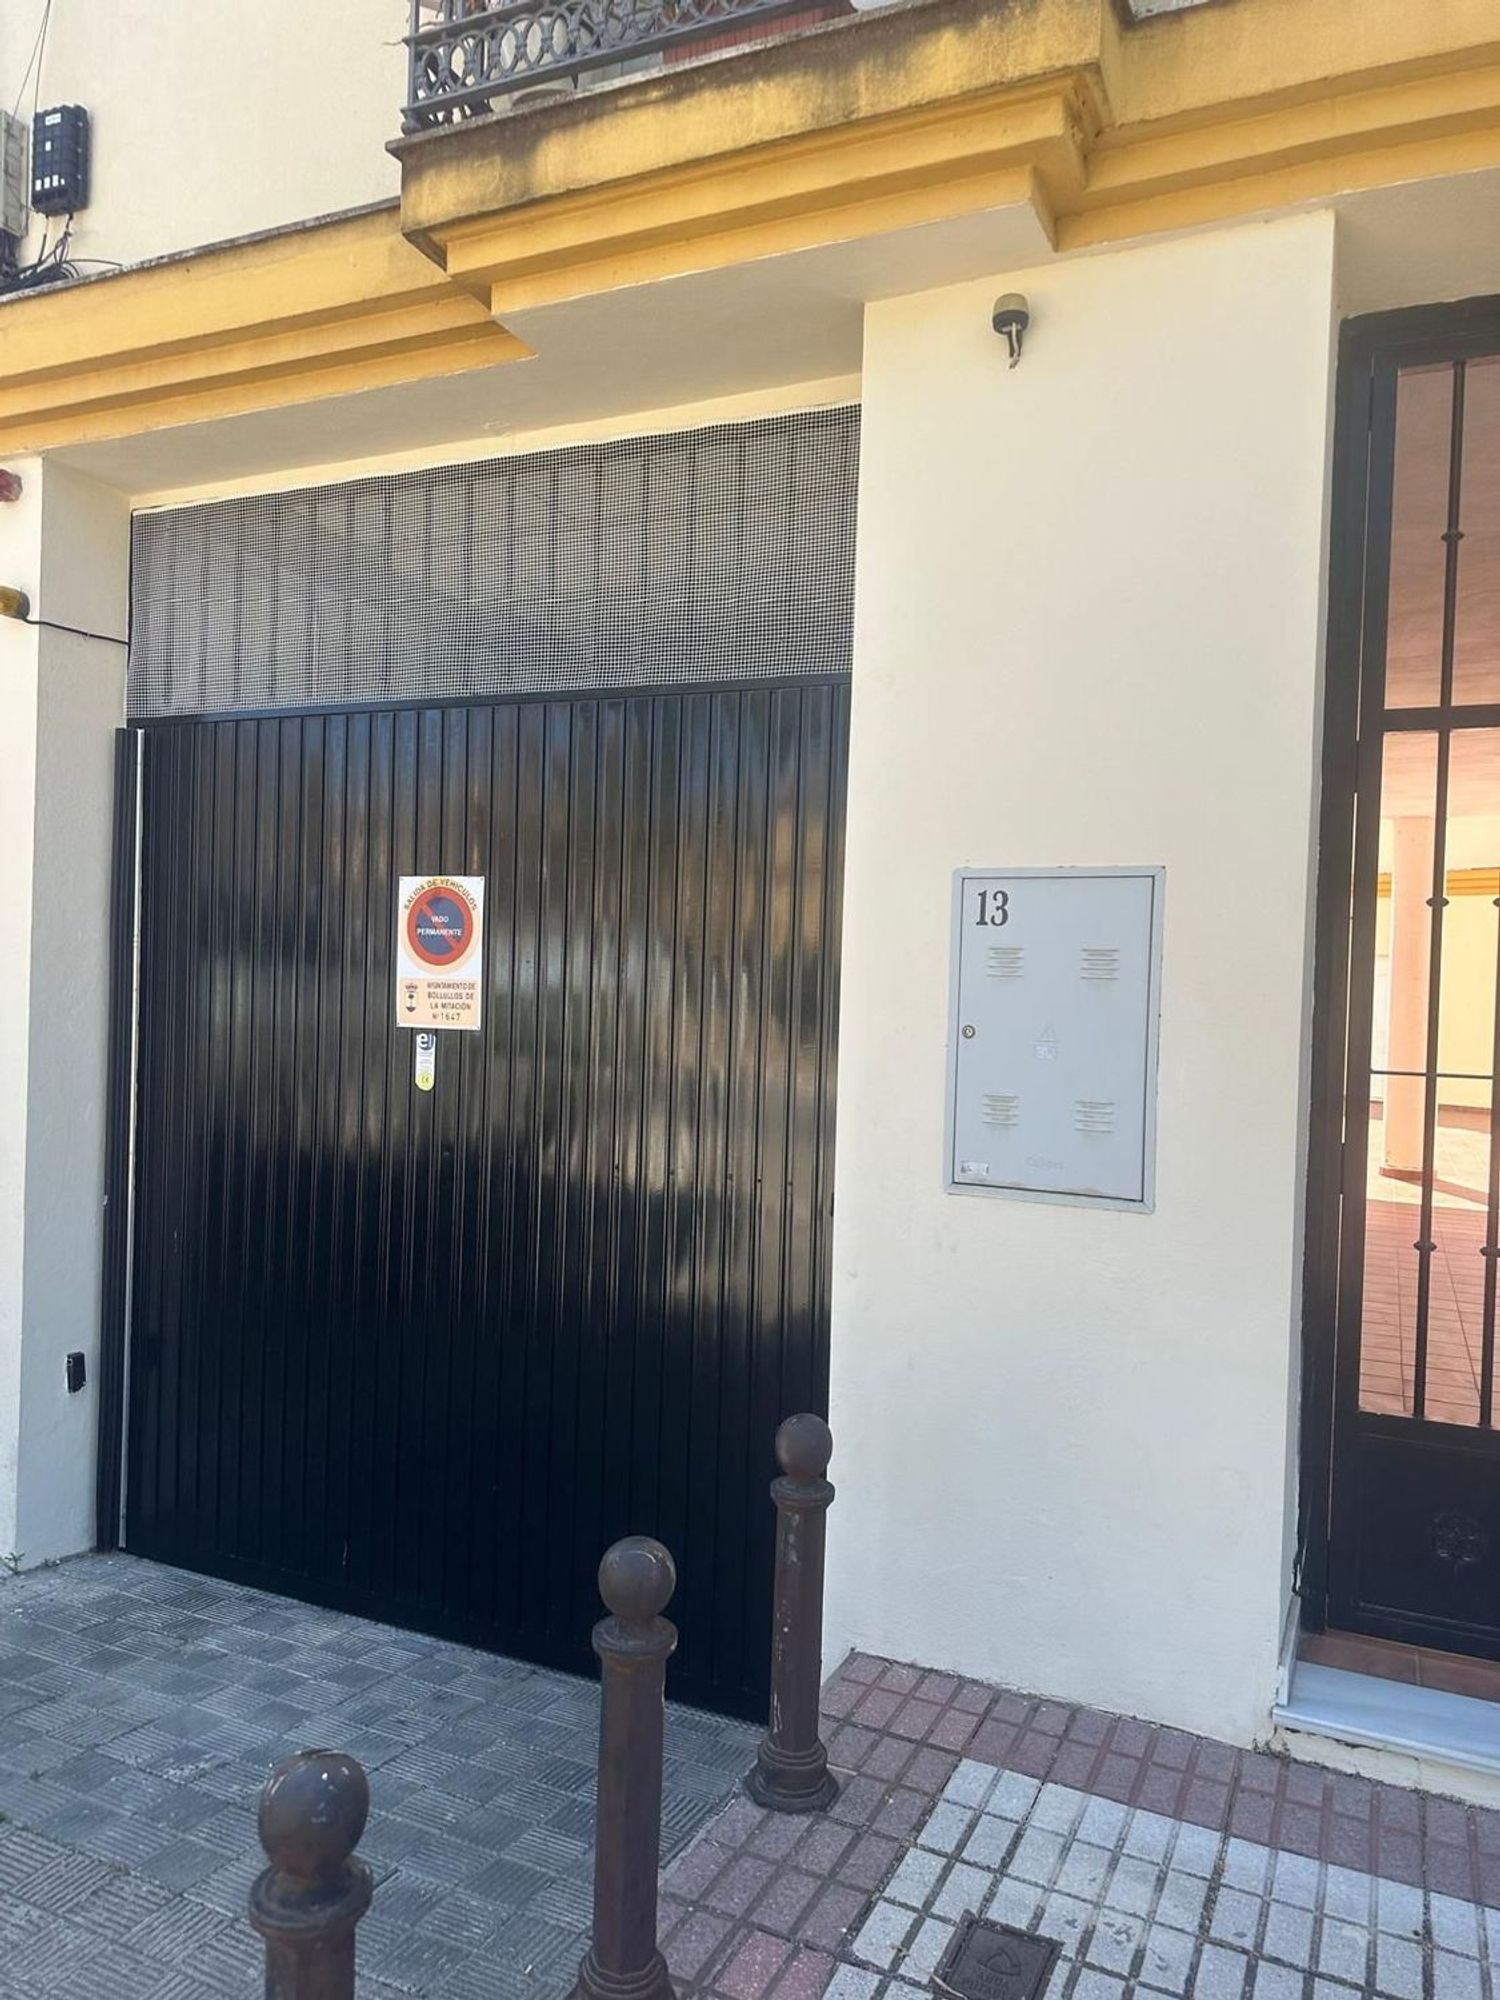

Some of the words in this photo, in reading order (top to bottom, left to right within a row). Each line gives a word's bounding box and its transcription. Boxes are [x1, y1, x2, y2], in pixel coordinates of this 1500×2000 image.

[404, 884, 426, 910] SALIDA
[427, 878, 437, 888] DE
[976, 890, 1009, 927] 13
[431, 915, 449, 923] VADO
[416, 928, 462, 936] PERMANENTE
[427, 982, 468, 990] AYUNTAMIENTO
[427, 991, 463, 1000] BOLLULLOS
[466, 992, 474, 1000] DE
[430, 1002, 439, 1010] LA
